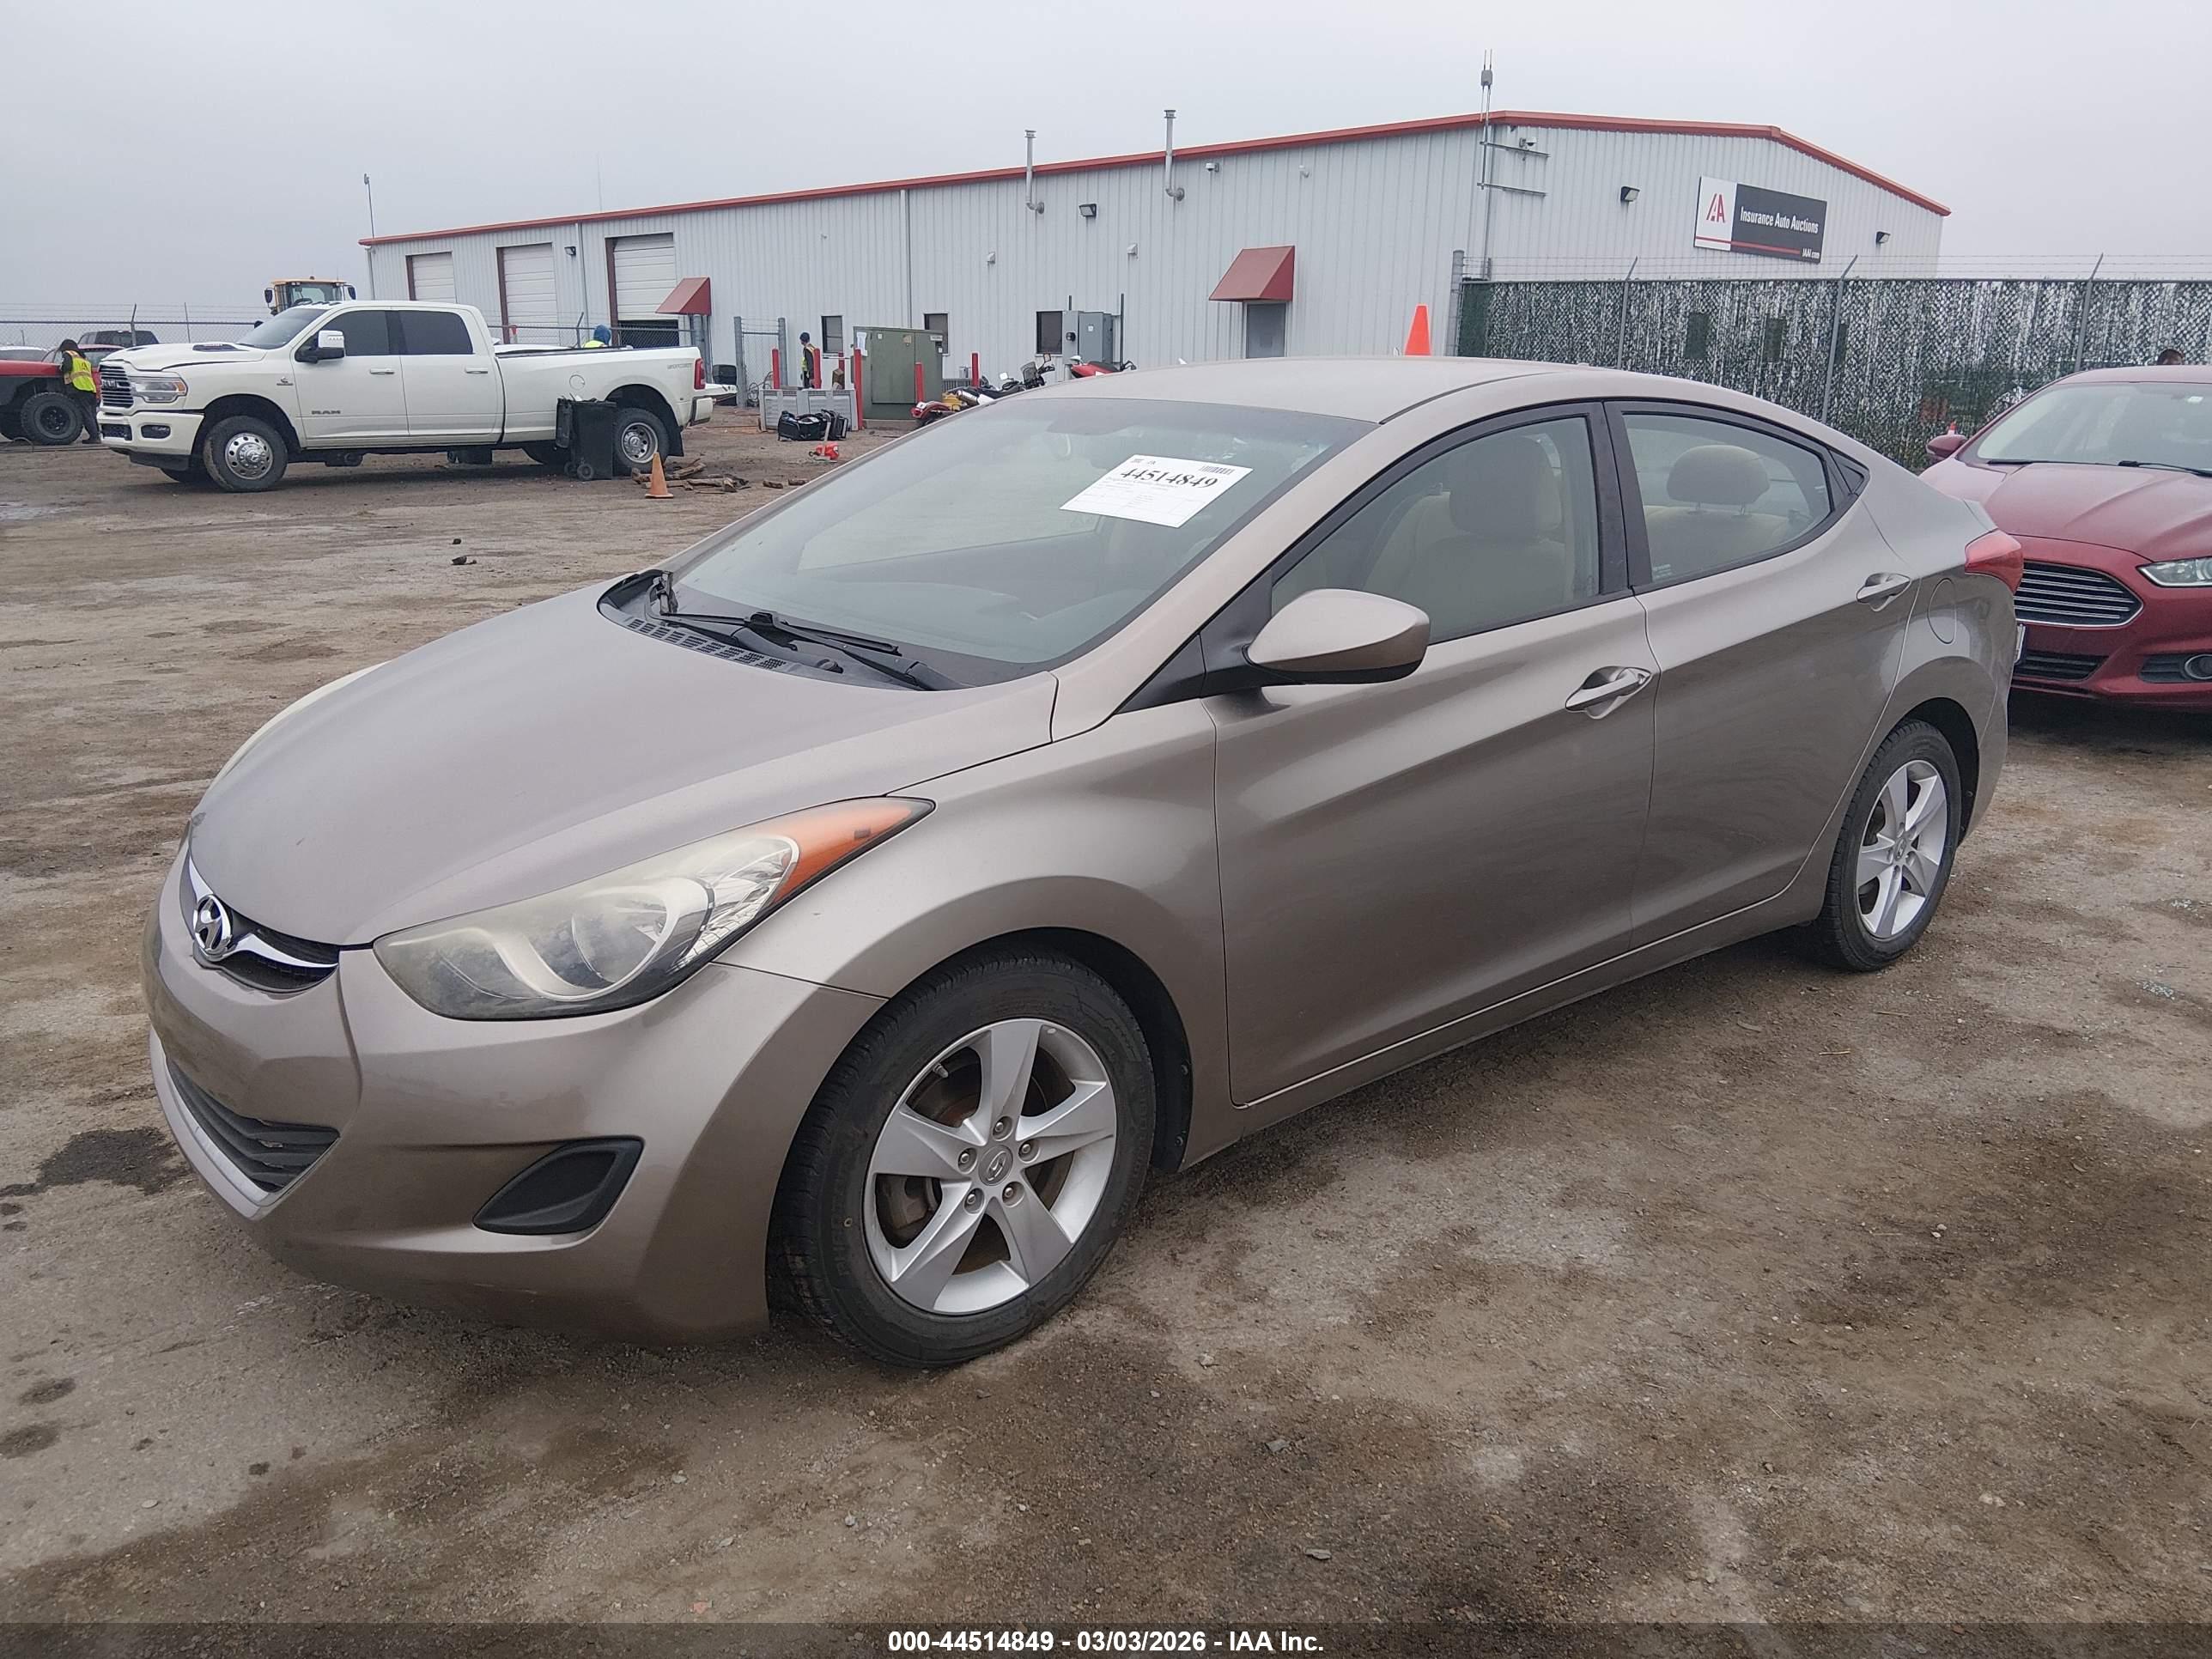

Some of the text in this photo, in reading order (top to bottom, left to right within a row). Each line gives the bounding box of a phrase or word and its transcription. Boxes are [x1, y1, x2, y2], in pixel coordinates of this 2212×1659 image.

[1740, 206, 1819, 234] Insurance Auto Auctions
[1121, 468, 1218, 489] 44514849
